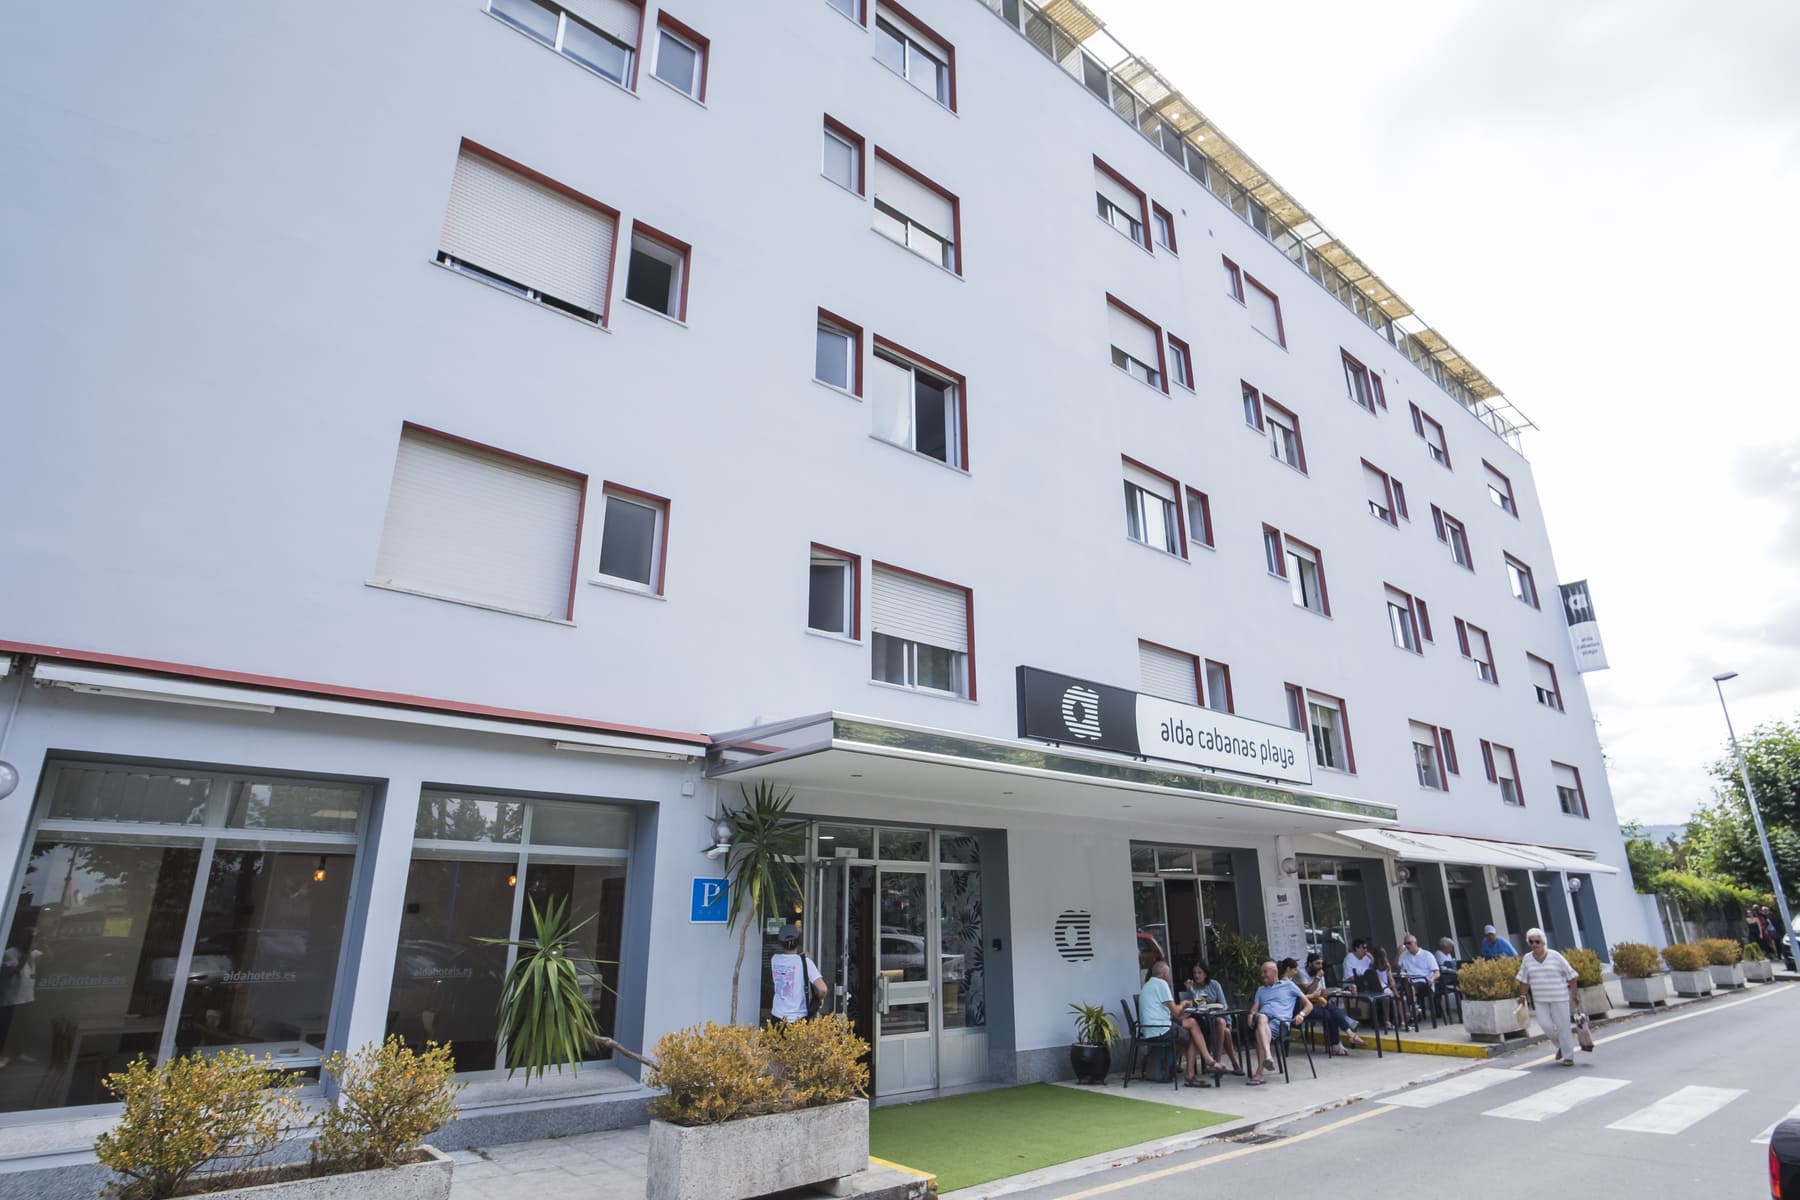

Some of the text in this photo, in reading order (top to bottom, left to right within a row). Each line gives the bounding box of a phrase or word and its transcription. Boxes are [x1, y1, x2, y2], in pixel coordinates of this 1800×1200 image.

[1161, 717, 1295, 769] alda cabanas playa
[701, 882, 720, 907] P
[223, 970, 296, 982] aldahotels.es
